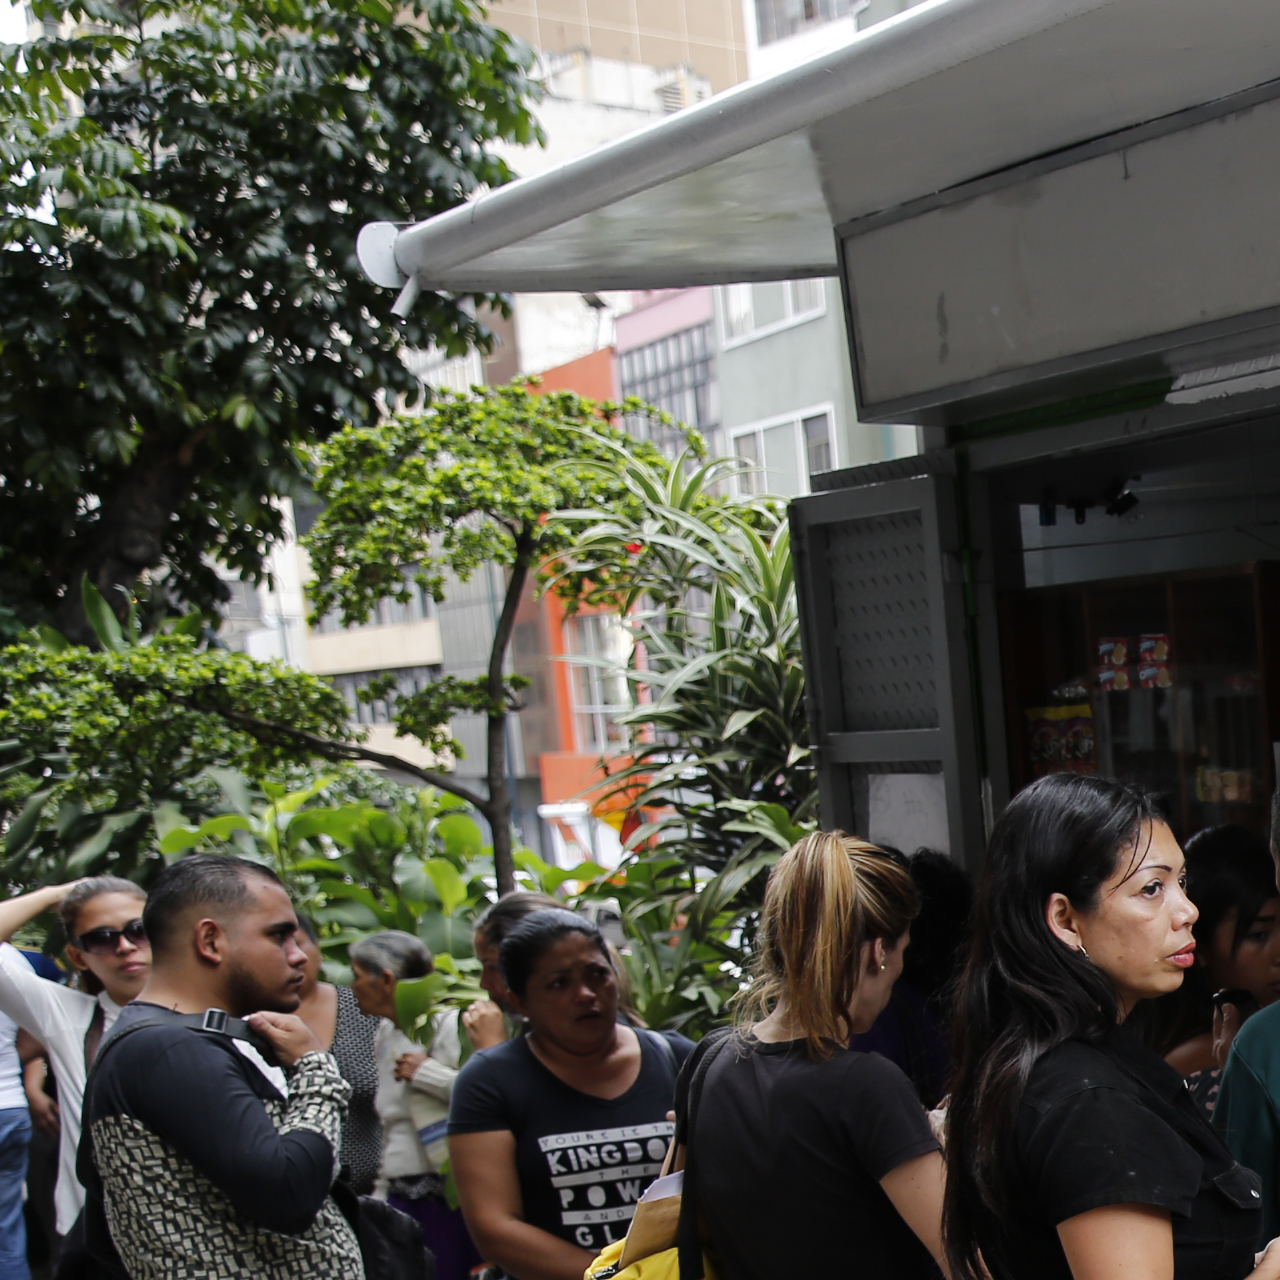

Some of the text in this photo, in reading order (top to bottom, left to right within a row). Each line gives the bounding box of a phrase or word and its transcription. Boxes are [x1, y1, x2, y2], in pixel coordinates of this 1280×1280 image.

[652, 1123, 675, 1134] TH
[546, 1137, 674, 1175] KINGDO
[558, 1179, 642, 1209] POW
[582, 1210, 626, 1223] AND
